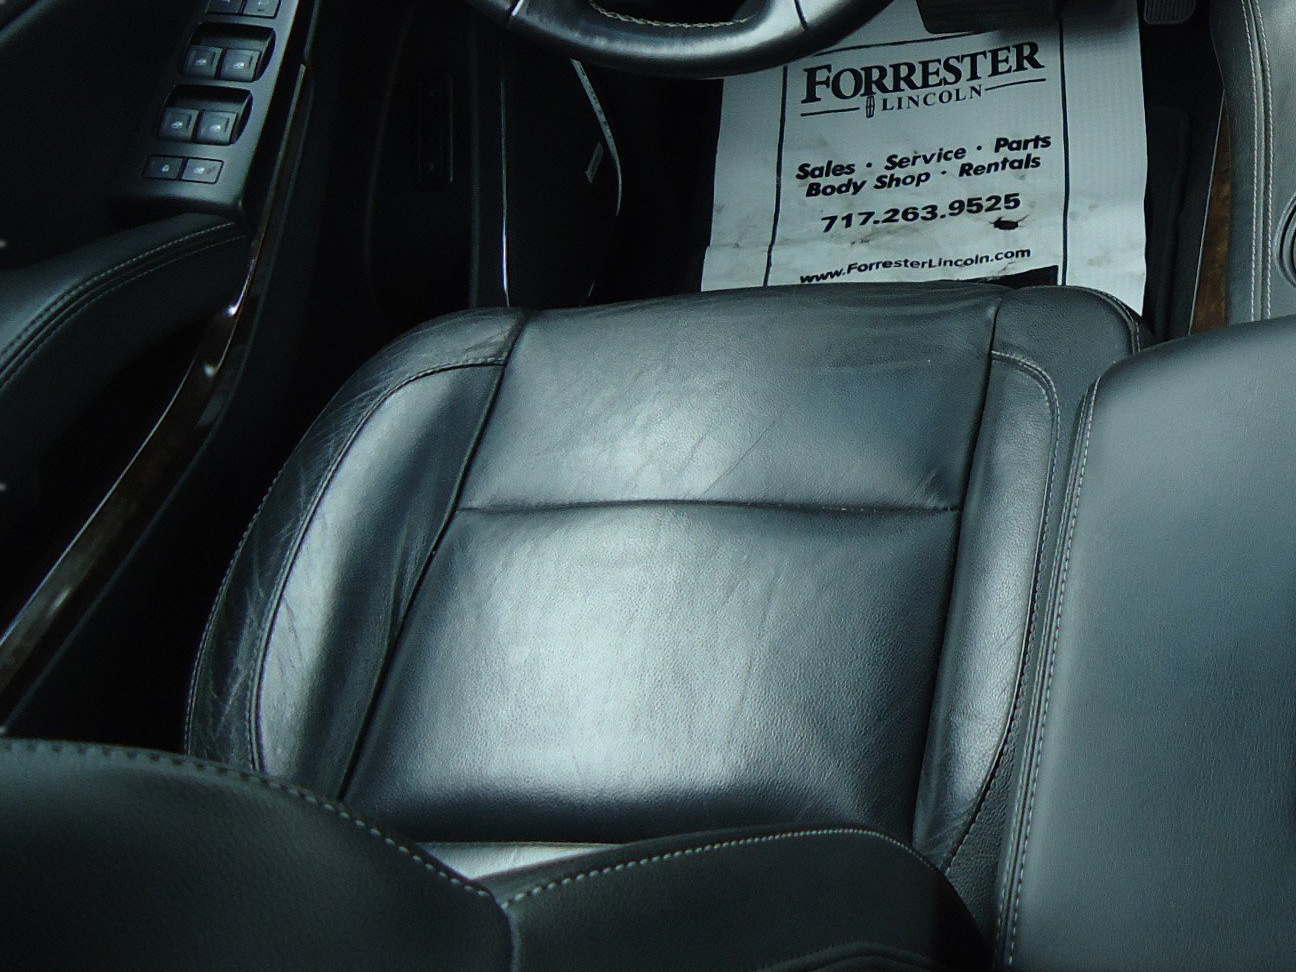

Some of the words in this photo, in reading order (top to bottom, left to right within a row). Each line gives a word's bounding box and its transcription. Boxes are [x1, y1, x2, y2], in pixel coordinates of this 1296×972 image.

[800, 40, 1045, 104] FORRESTER
[880, 84, 983, 112] LINCOLN
[796, 160, 856, 180] Sales
[884, 147, 967, 171] Service
[994, 135, 1052, 154] Parts
[805, 178, 867, 197] Body
[873, 170, 931, 190] Shop
[958, 153, 1042, 178] Rentals
[821, 192, 1021, 232] 717.263.9525
[800, 247, 1032, 283] www.ForresterLincoln.com
